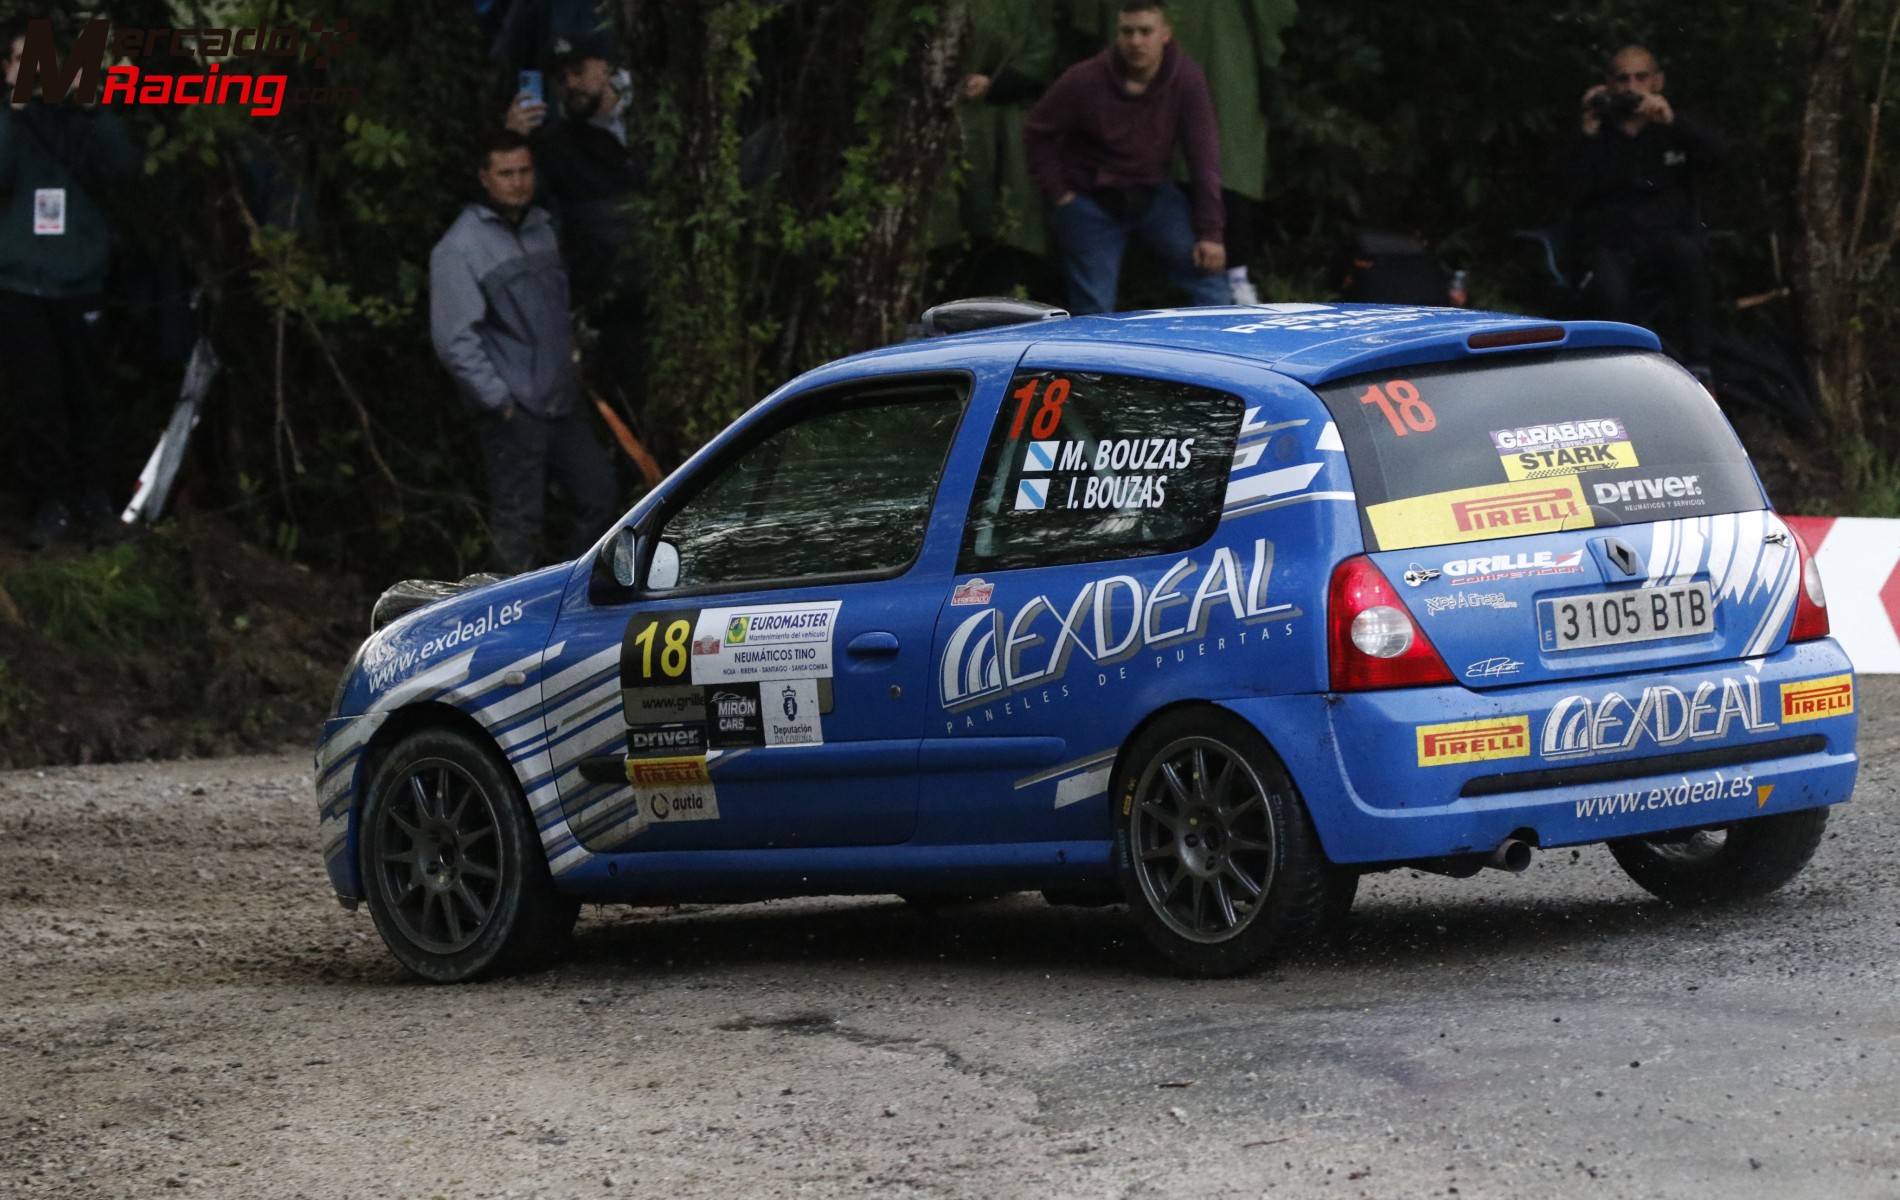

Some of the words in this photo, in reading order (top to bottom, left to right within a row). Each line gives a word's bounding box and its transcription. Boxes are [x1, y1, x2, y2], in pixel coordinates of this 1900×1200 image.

[1009, 378, 1071, 440] 18
[1359, 379, 1438, 438] 18
[1497, 419, 1620, 449] GARABATO
[1059, 440, 1088, 471] M.
[1093, 438, 1195, 471] BOUZAS
[1518, 444, 1617, 471] STARK
[1066, 476, 1078, 509] I.
[1083, 475, 1168, 509] BOUZAS
[1673, 498, 1706, 507] SERVICIOS
[1451, 487, 1580, 532] PIRELLI
[1443, 551, 1557, 576] GRILLE
[750, 612, 828, 631] EUROMASTER
[1561, 597, 1641, 642] 3105
[1650, 589, 1706, 631] BTB
[368, 599, 523, 695] www.exdeal.es
[635, 619, 691, 679] 18
[748, 632, 790, 641] Mantenimiento
[790, 631, 801, 639] del
[1545, 630, 1553, 641] E
[734, 647, 793, 663] NEUMÁTICOS
[795, 647, 816, 660] TINO
[762, 665, 788, 673] SANTIAGO
[791, 664, 808, 672] SANTA
[808, 663, 828, 671] COMBA
[946, 684, 1069, 734] PANELES
[1098, 667, 1127, 687] DE
[1156, 622, 1293, 669] PUERTAS
[718, 696, 757, 717] MIRÓN
[1784, 683, 1851, 717] PIRELLI
[719, 717, 745, 731] CARS
[773, 723, 812, 736] Deputación
[1424, 724, 1524, 758] PIRELLI
[672, 793, 703, 810] autia
[1576, 772, 1753, 819] www.exdeal.es
